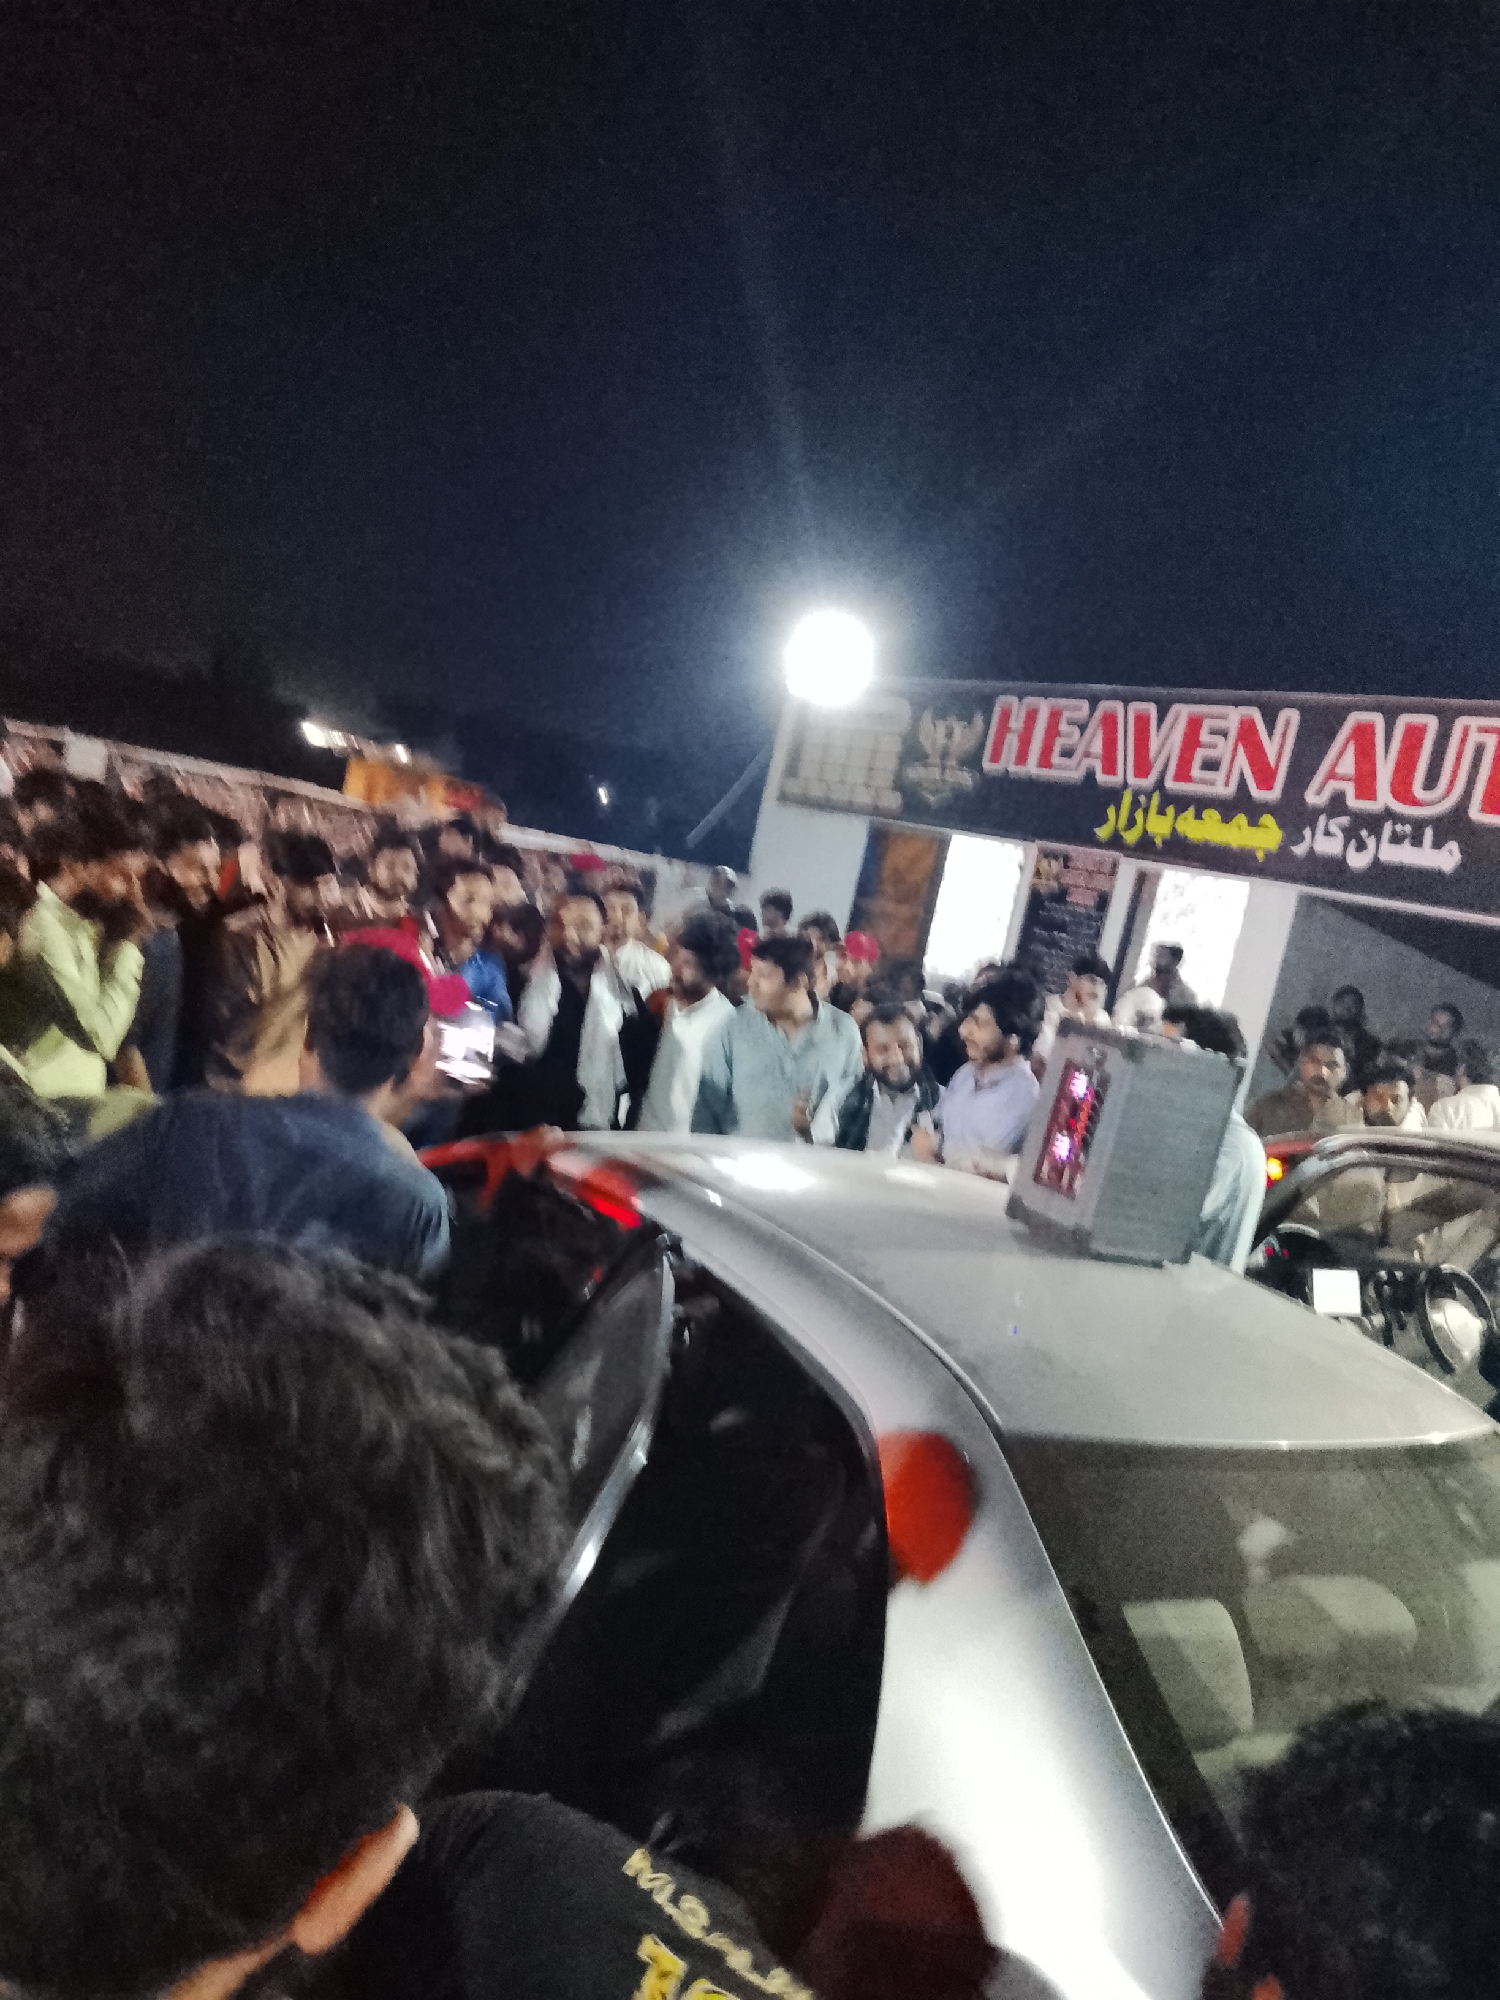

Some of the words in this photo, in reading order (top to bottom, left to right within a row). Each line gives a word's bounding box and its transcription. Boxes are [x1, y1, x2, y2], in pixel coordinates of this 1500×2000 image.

[983, 695, 1300, 804] HEAVEN
[1093, 788, 1176, 848] بازار
[1291, 812, 1351, 858] کار
[1345, 819, 1462, 873] ملتان
